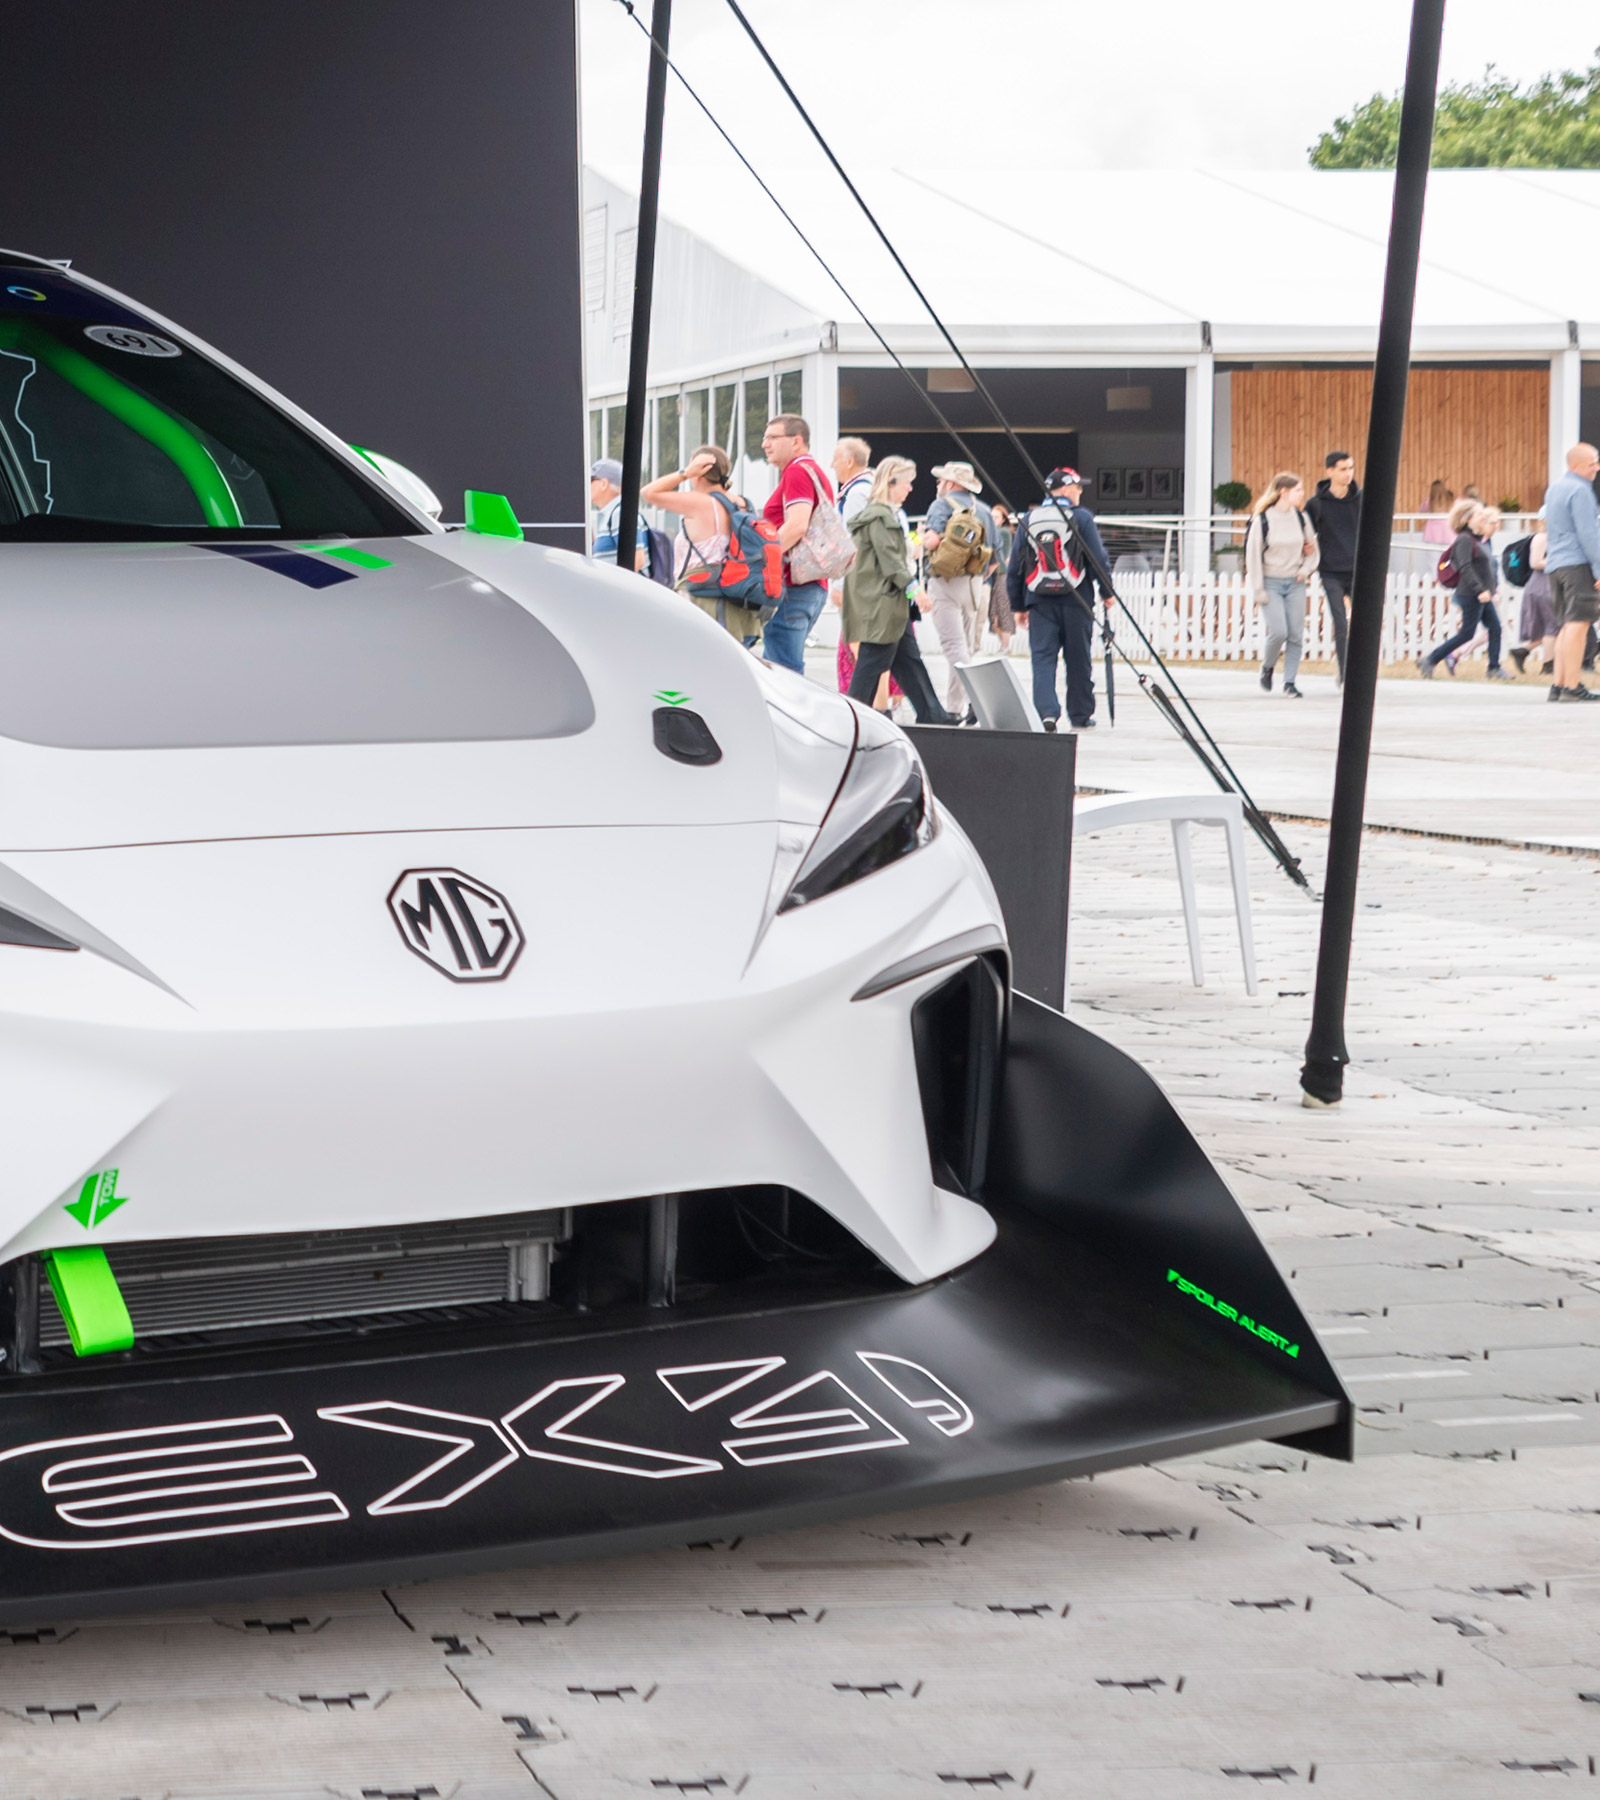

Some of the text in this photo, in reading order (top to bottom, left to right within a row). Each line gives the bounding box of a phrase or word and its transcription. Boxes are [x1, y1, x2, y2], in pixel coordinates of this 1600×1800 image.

[399, 876, 513, 971] MG
[99, 1169, 117, 1208] TOW
[1176, 1277, 1291, 1351] SPOILER ALERT
